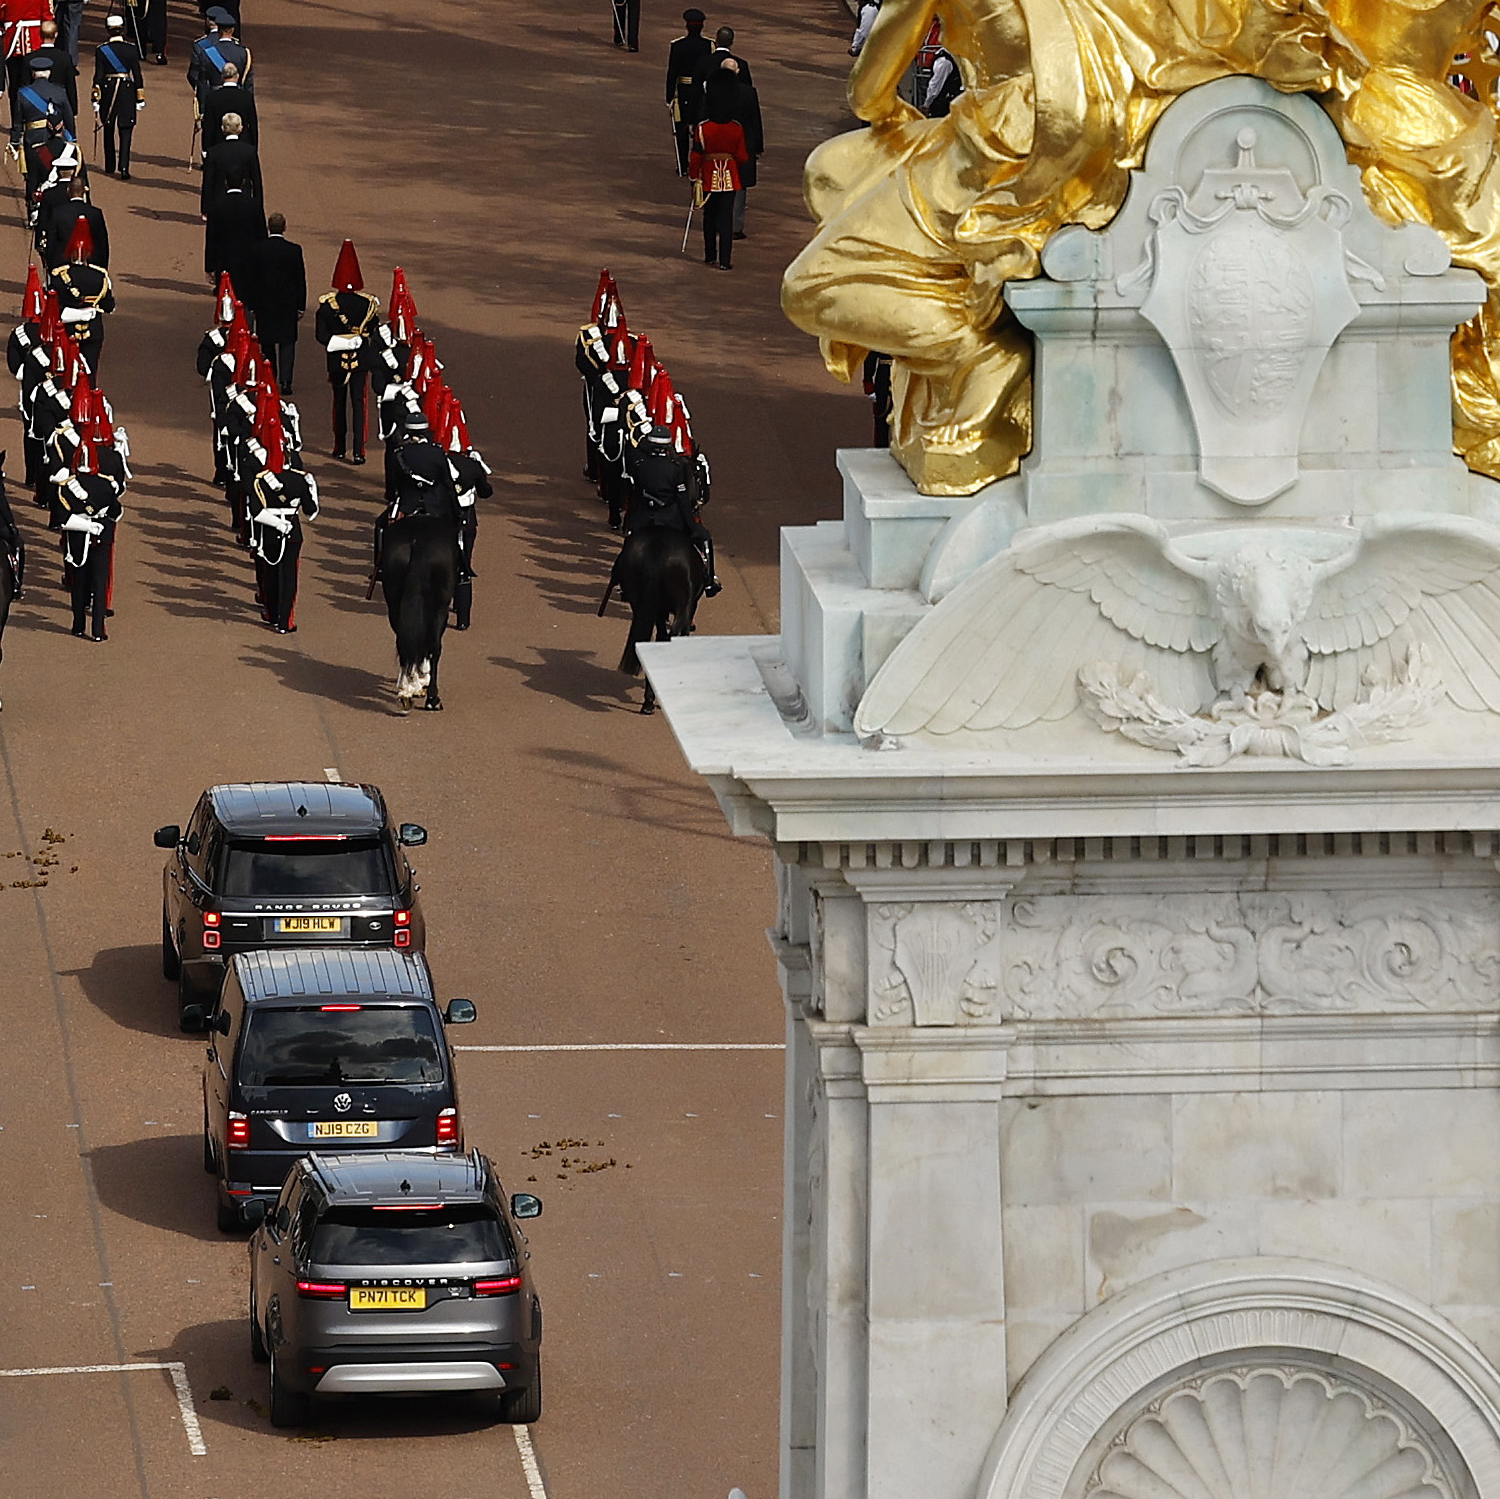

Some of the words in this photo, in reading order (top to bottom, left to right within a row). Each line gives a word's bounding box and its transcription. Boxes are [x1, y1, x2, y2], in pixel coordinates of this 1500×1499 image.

[284, 918, 309, 929] WJ19
[313, 918, 335, 929] HLW
[315, 1123, 343, 1135] NJ19
[346, 1123, 369, 1135] CZG
[359, 1291, 388, 1303] PN71
[392, 1290, 417, 1303] TCK
